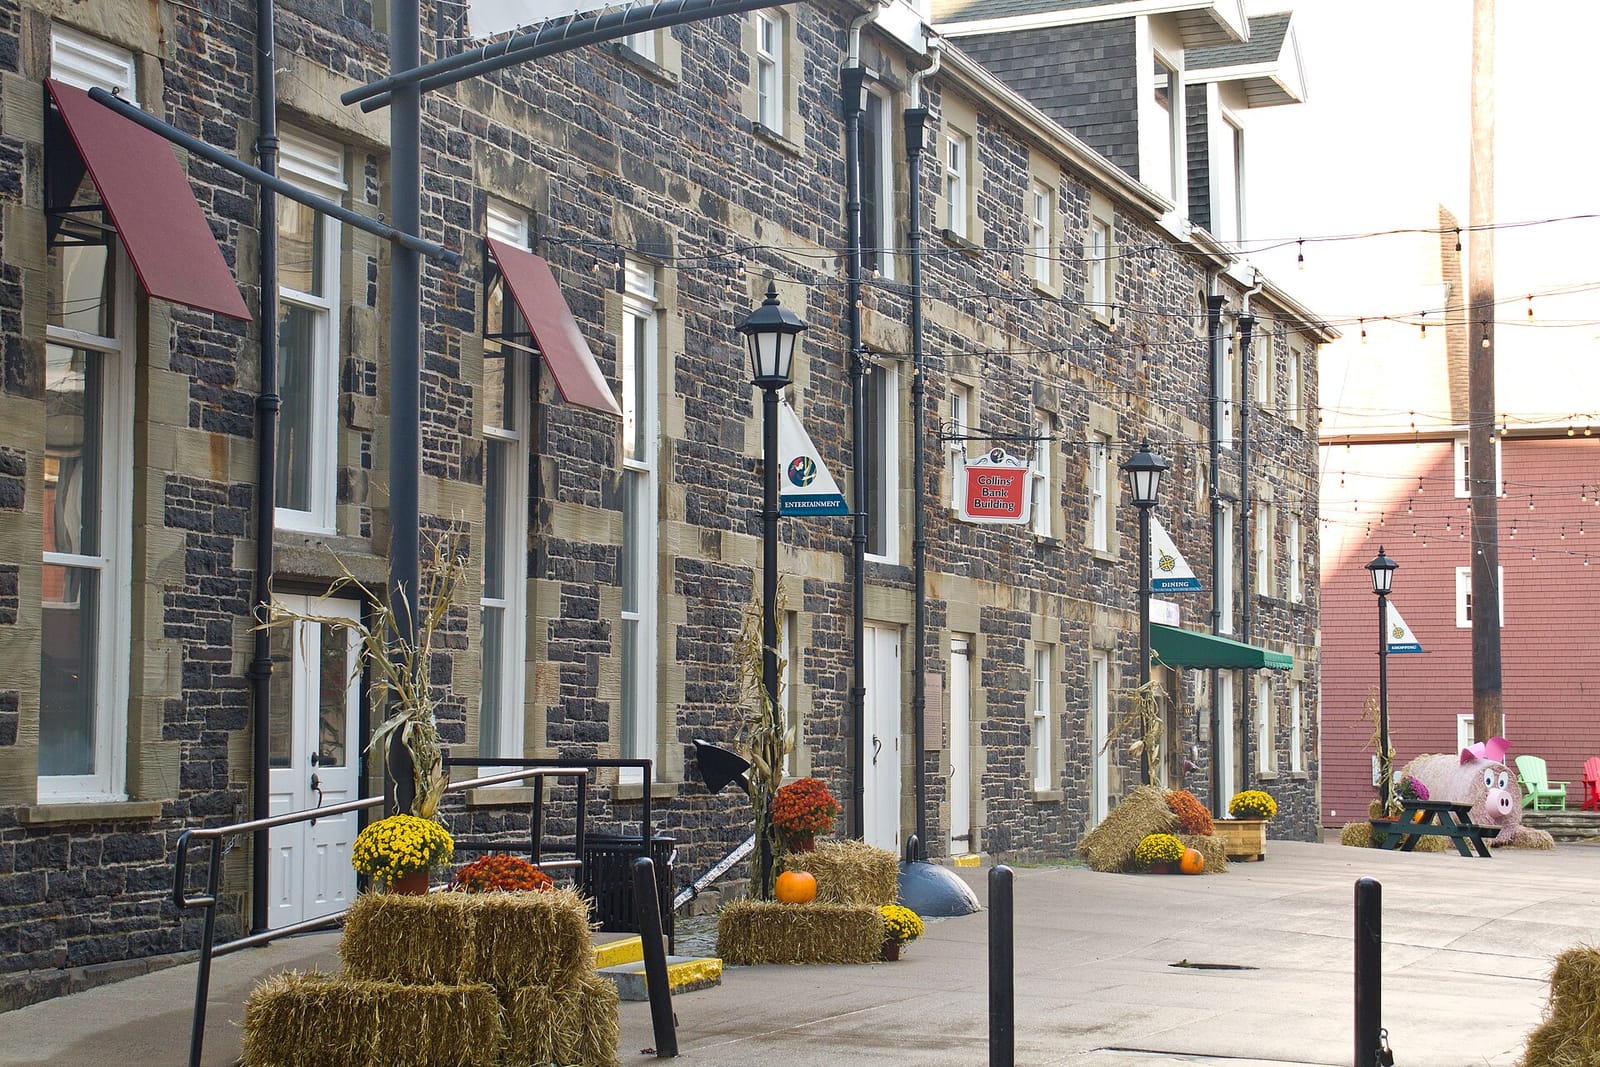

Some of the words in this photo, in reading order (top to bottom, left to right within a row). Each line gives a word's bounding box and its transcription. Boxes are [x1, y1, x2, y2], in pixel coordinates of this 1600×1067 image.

[978, 475, 1015, 486] Collins'
[982, 487, 1008, 497] Bank
[784, 500, 841, 508] ENTERTAINMENT
[974, 498, 1014, 512] Building
